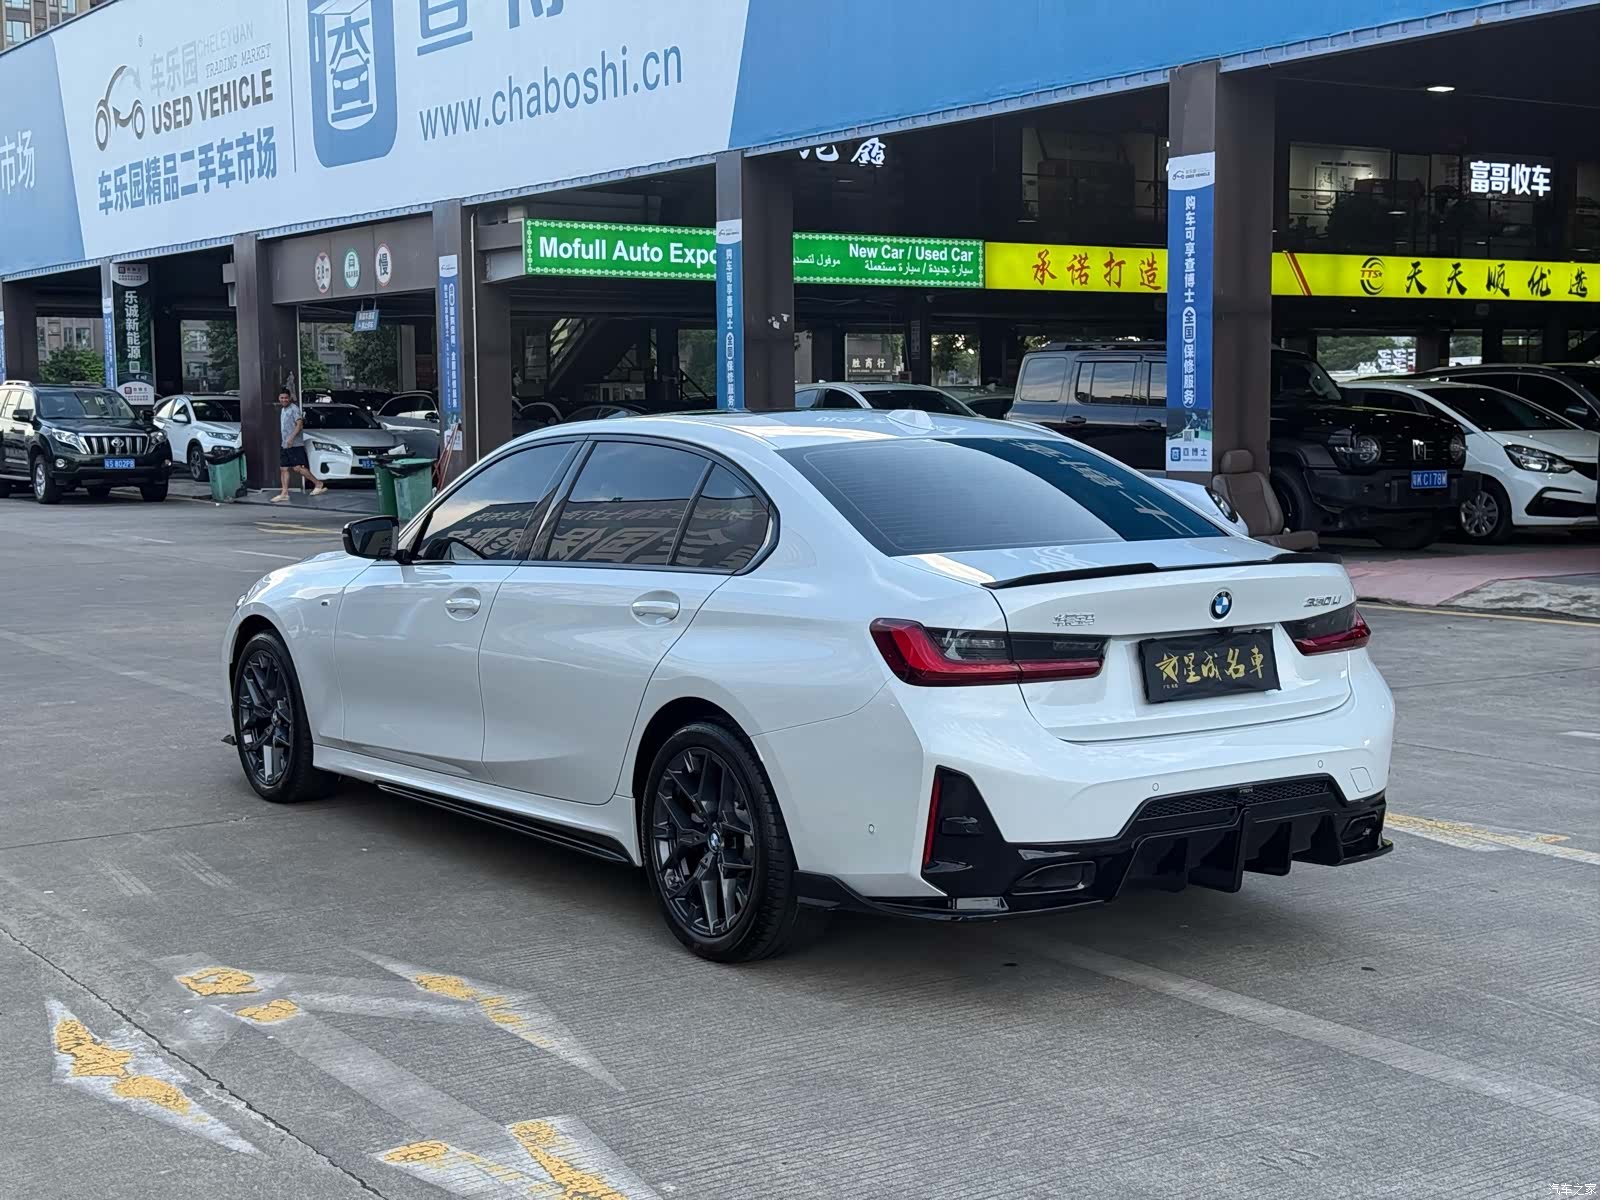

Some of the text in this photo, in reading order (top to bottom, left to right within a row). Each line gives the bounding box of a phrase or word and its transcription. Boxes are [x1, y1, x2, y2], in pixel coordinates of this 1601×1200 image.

[197, 22, 254, 58] CHELEYUAN
[150, 40, 199, 96] 车乐园
[205, 43, 272, 78] TRADING MARKET
[151, 68, 274, 134] USED VEHICLE
[419, 45, 683, 142] www.chaboshi.cn
[98, 126, 278, 216] 车乐园精品二手车市场
[1469, 160, 1552, 197] 富哥收车
[379, 253, 389, 276] 慢
[539, 236, 607, 261] Mofull
[612, 239, 664, 263] Auto
[849, 243, 879, 259] New
[881, 245, 905, 260] Car
[915, 246, 948, 261] Used
[951, 247, 974, 262] Car
[1032, 249, 1161, 290] 承诺打造
[1405, 261, 1588, 298] 天天顺优选
[124, 290, 141, 359] 乐诚新能源
